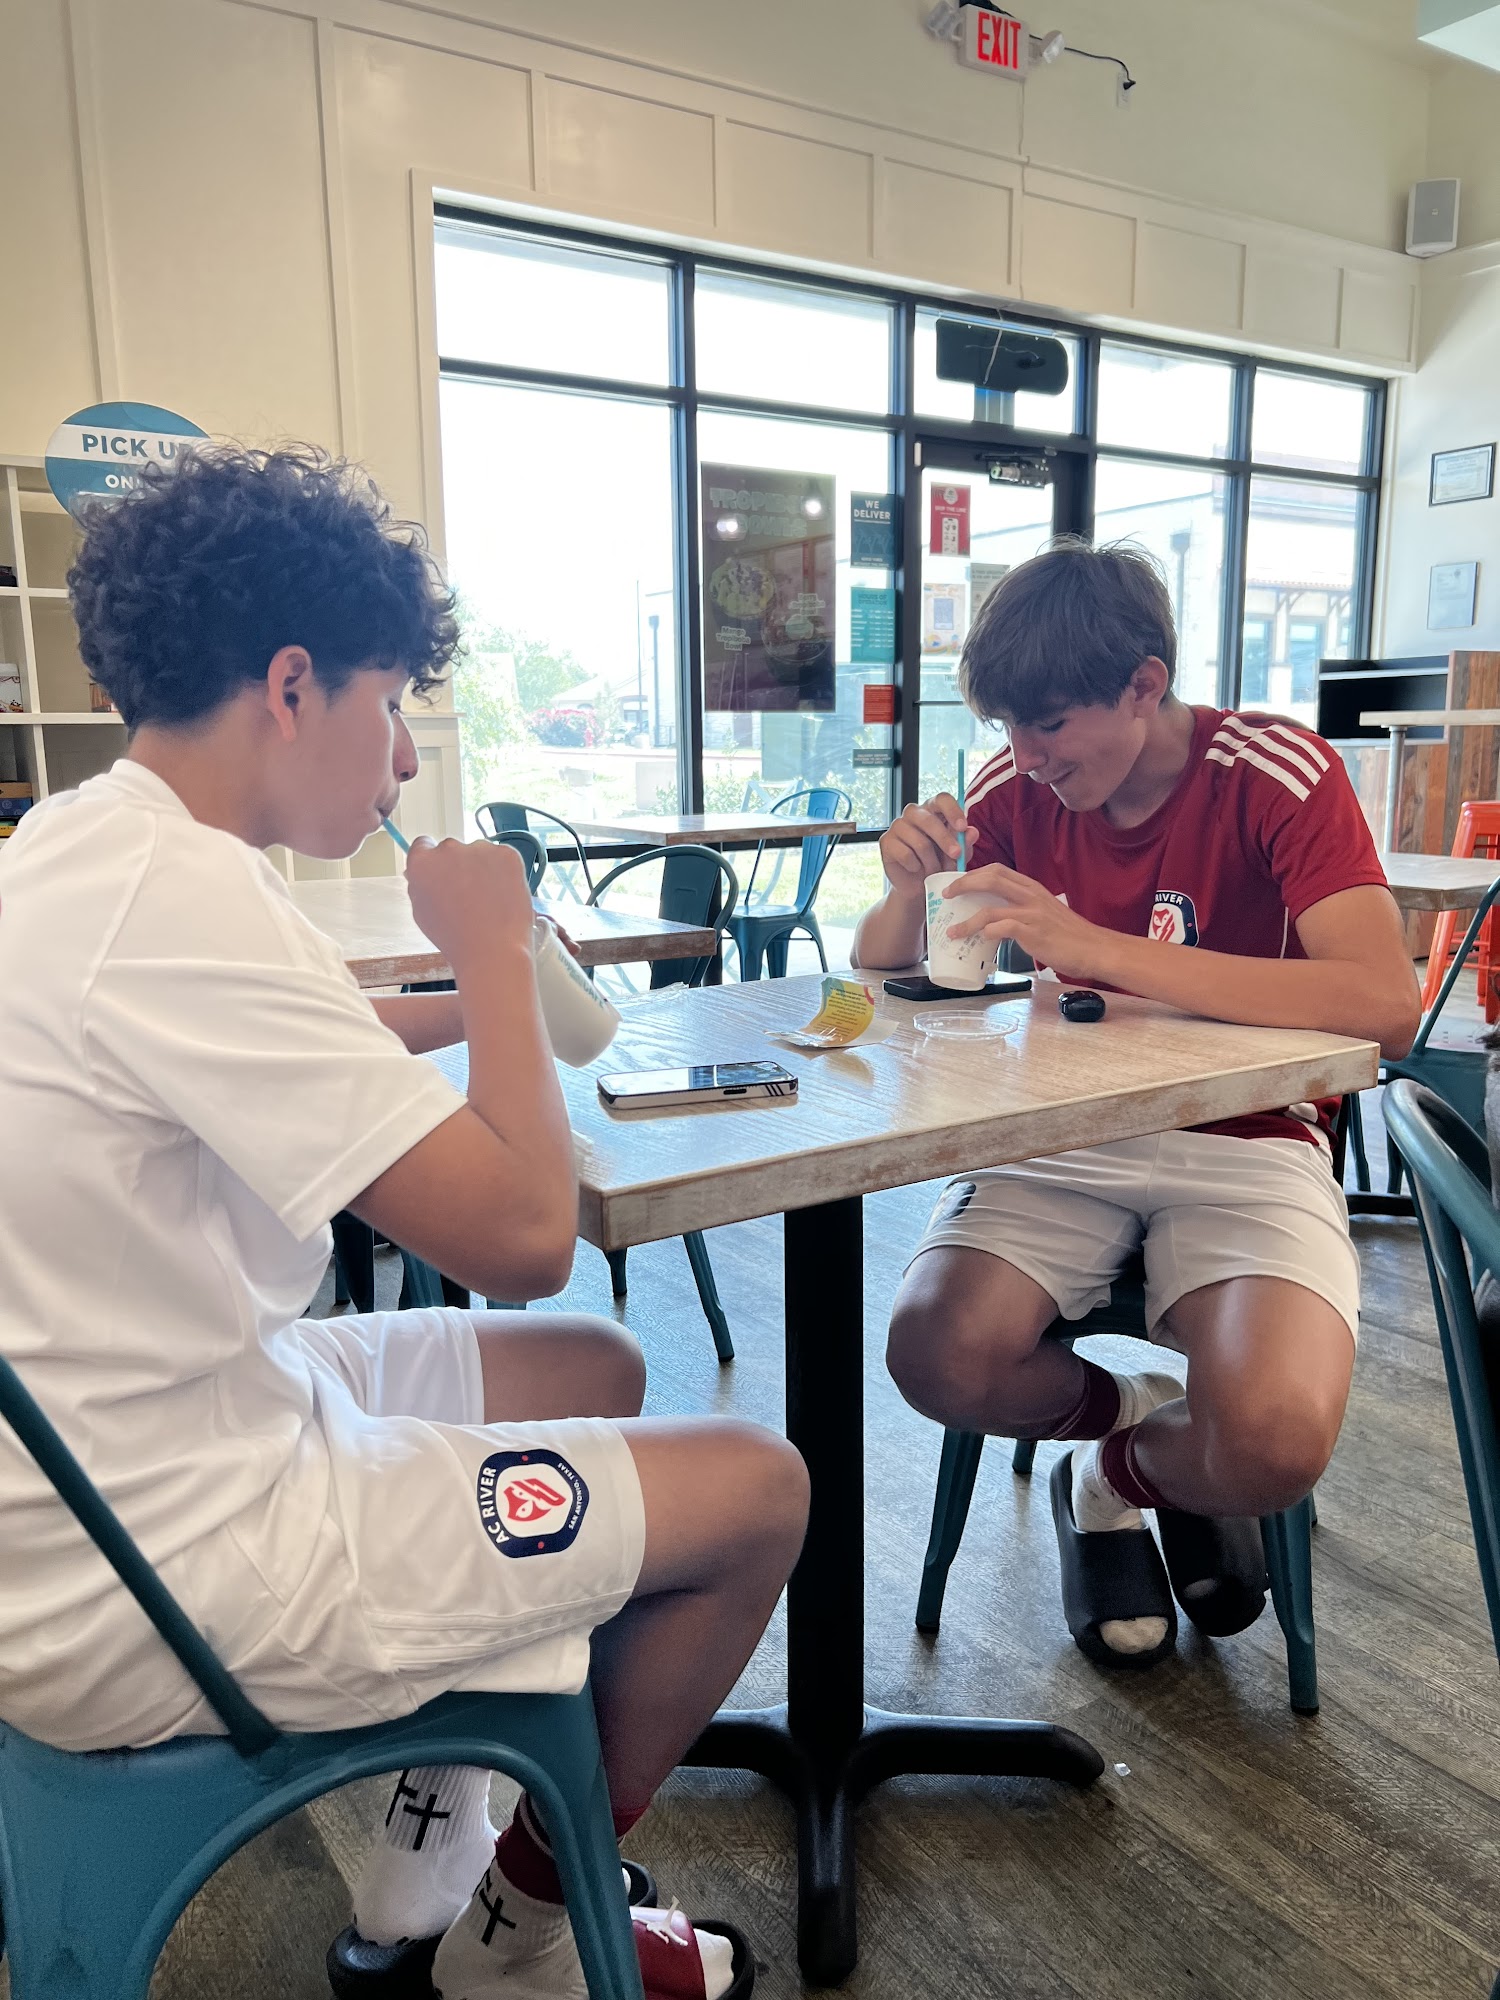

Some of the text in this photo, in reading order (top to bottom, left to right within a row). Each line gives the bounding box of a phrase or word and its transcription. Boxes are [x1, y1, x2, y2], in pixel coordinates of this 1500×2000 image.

[977, 10, 1021, 70] EXIT
[82, 433, 148, 458] PICK
[853, 508, 891, 520] DELIVER
[864, 499, 880, 509] WE
[480, 1466, 510, 1544] AC RIVER
[557, 1462, 583, 1530] SAN ANTONIO, TEXAS
